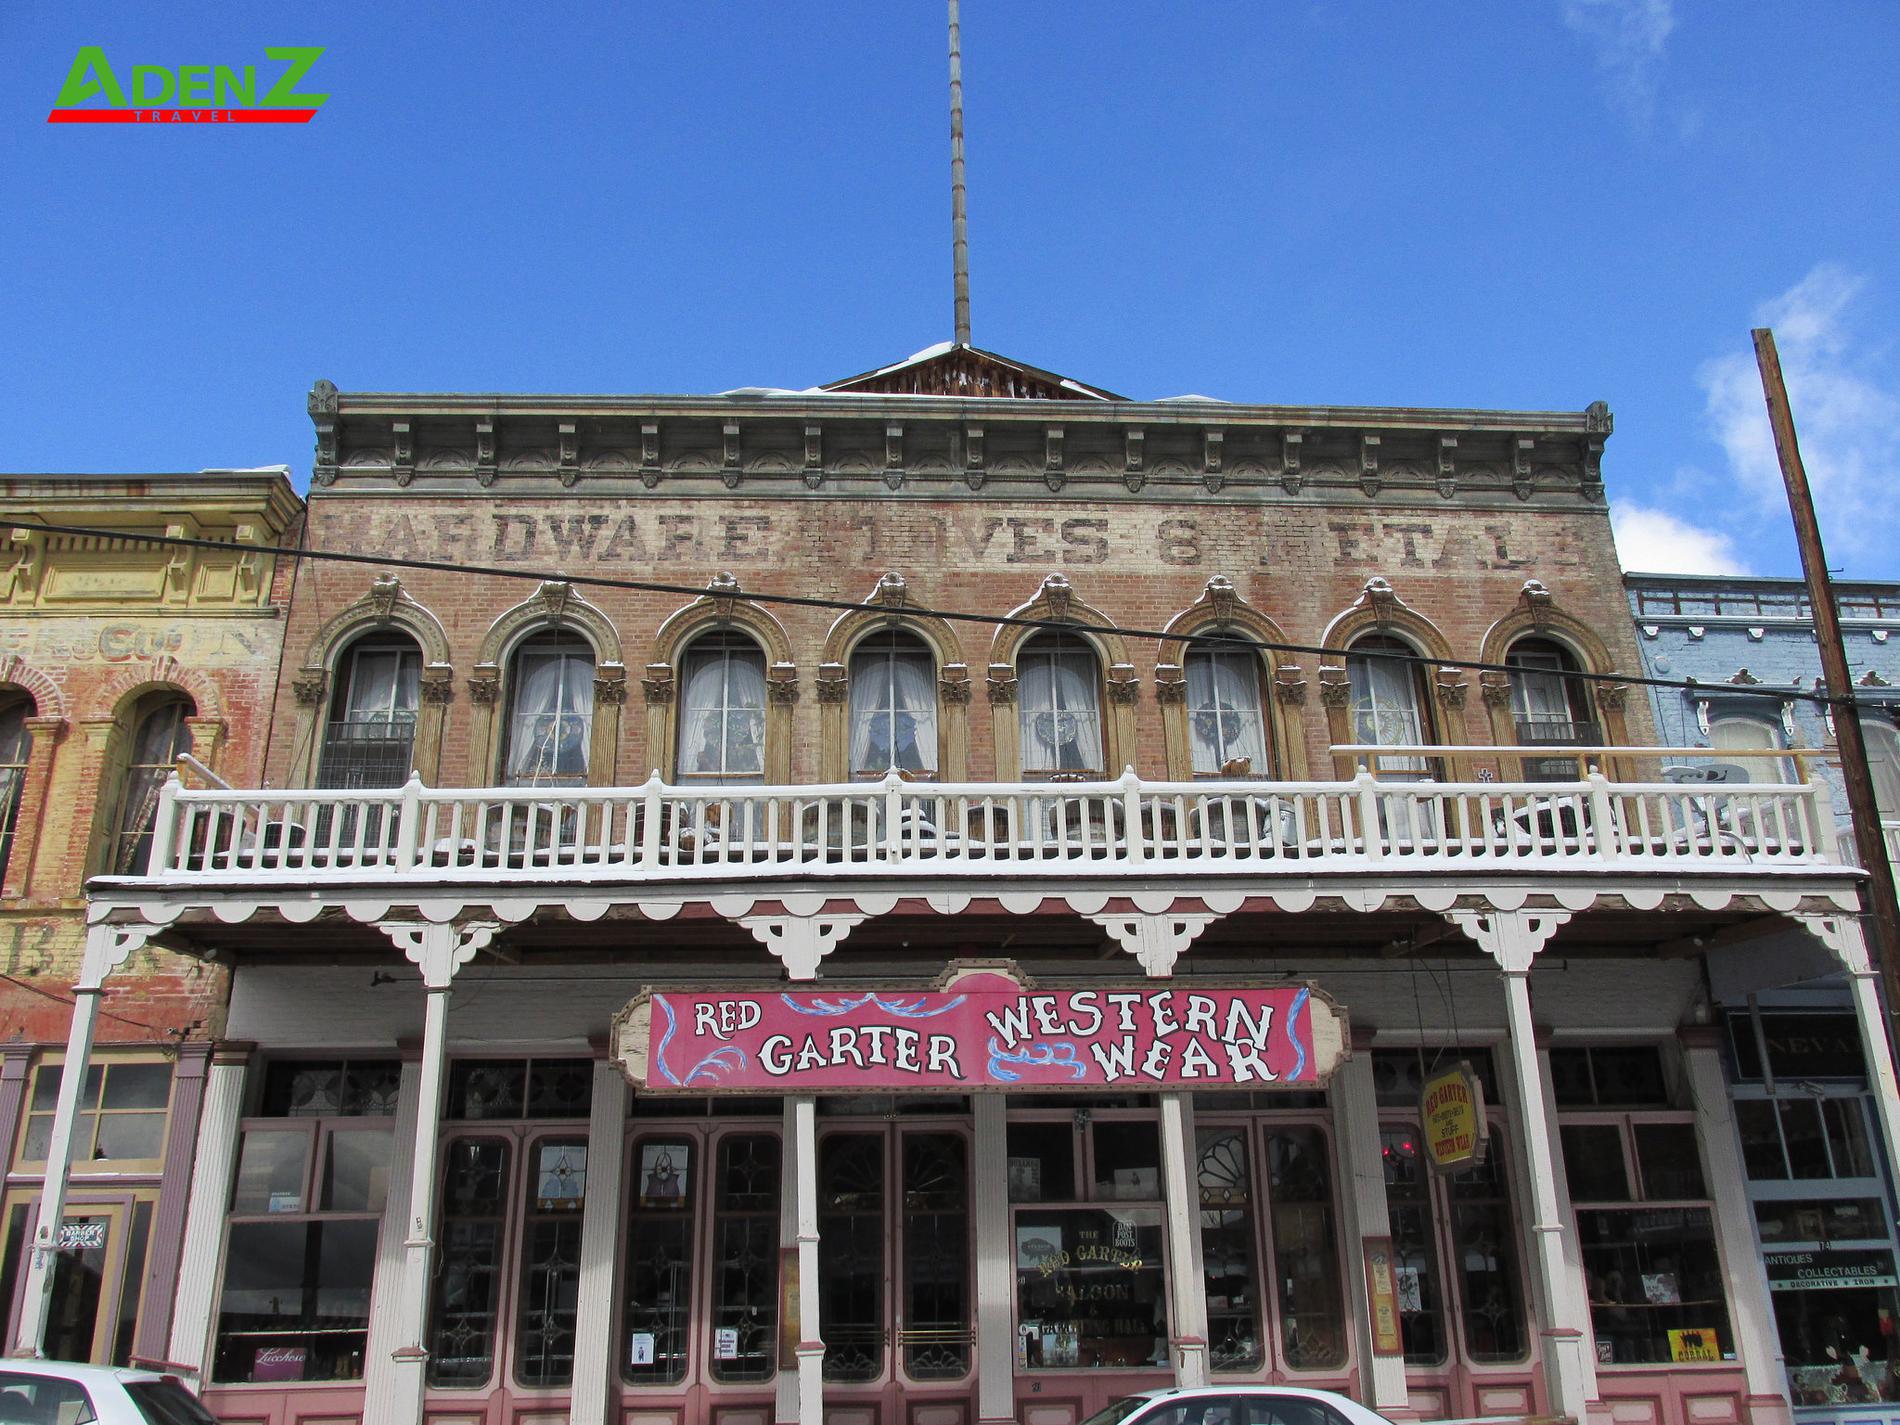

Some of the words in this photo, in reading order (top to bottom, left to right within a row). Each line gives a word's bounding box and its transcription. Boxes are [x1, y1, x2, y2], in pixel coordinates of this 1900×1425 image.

[695, 1000, 762, 1041] RED
[985, 990, 1274, 1051] WESTERN
[756, 1025, 967, 1081] GARTER
[1090, 1035, 1280, 1083] WEAR
[1079, 1231, 1099, 1239] THE
[1115, 1238, 1136, 1247] BOOTS
[1764, 1253, 1813, 1265] ANTIQUES
[1797, 1265, 1878, 1278] COLLECTABLES
[1790, 1280, 1838, 1288] DECORATIVE
[1854, 1278, 1875, 1286] IRON
[256, 1348, 306, 1366] Lucchese
